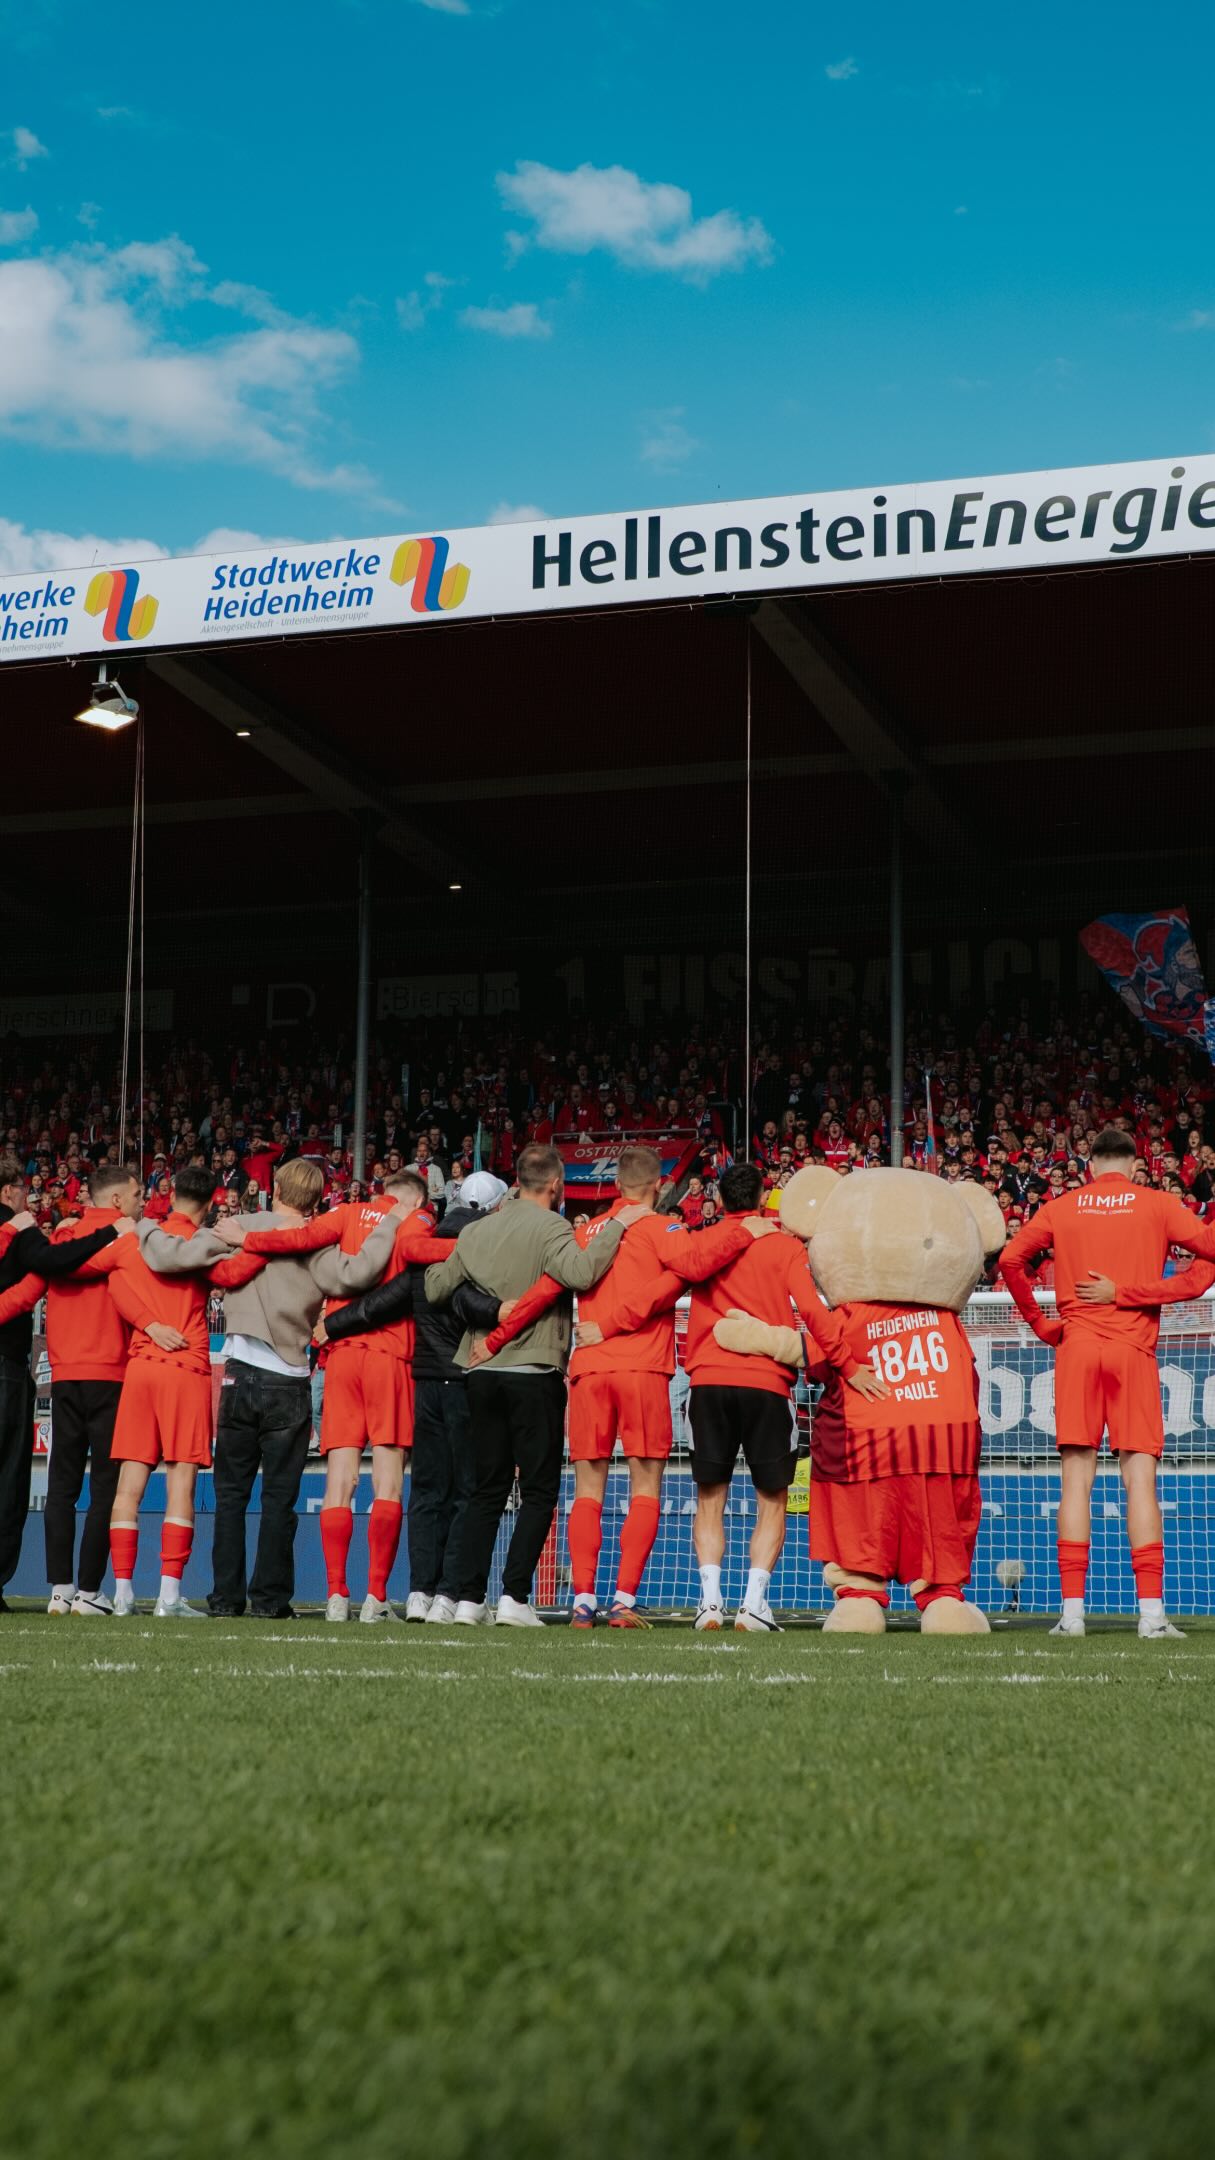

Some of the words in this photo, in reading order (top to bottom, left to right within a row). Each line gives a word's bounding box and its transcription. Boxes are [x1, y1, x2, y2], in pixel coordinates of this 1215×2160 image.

[532, 466, 1215, 589] HellensteinEnergie
[211, 549, 380, 590] Stadtwerke
[203, 582, 374, 621] Heidenheim
[0, 612, 69, 641] heim
[1096, 1193, 1136, 1208] MHP
[866, 1310, 940, 1340] HEIDENHEIM
[867, 1331, 949, 1383] 1846
[895, 1380, 939, 1402] PAULE
